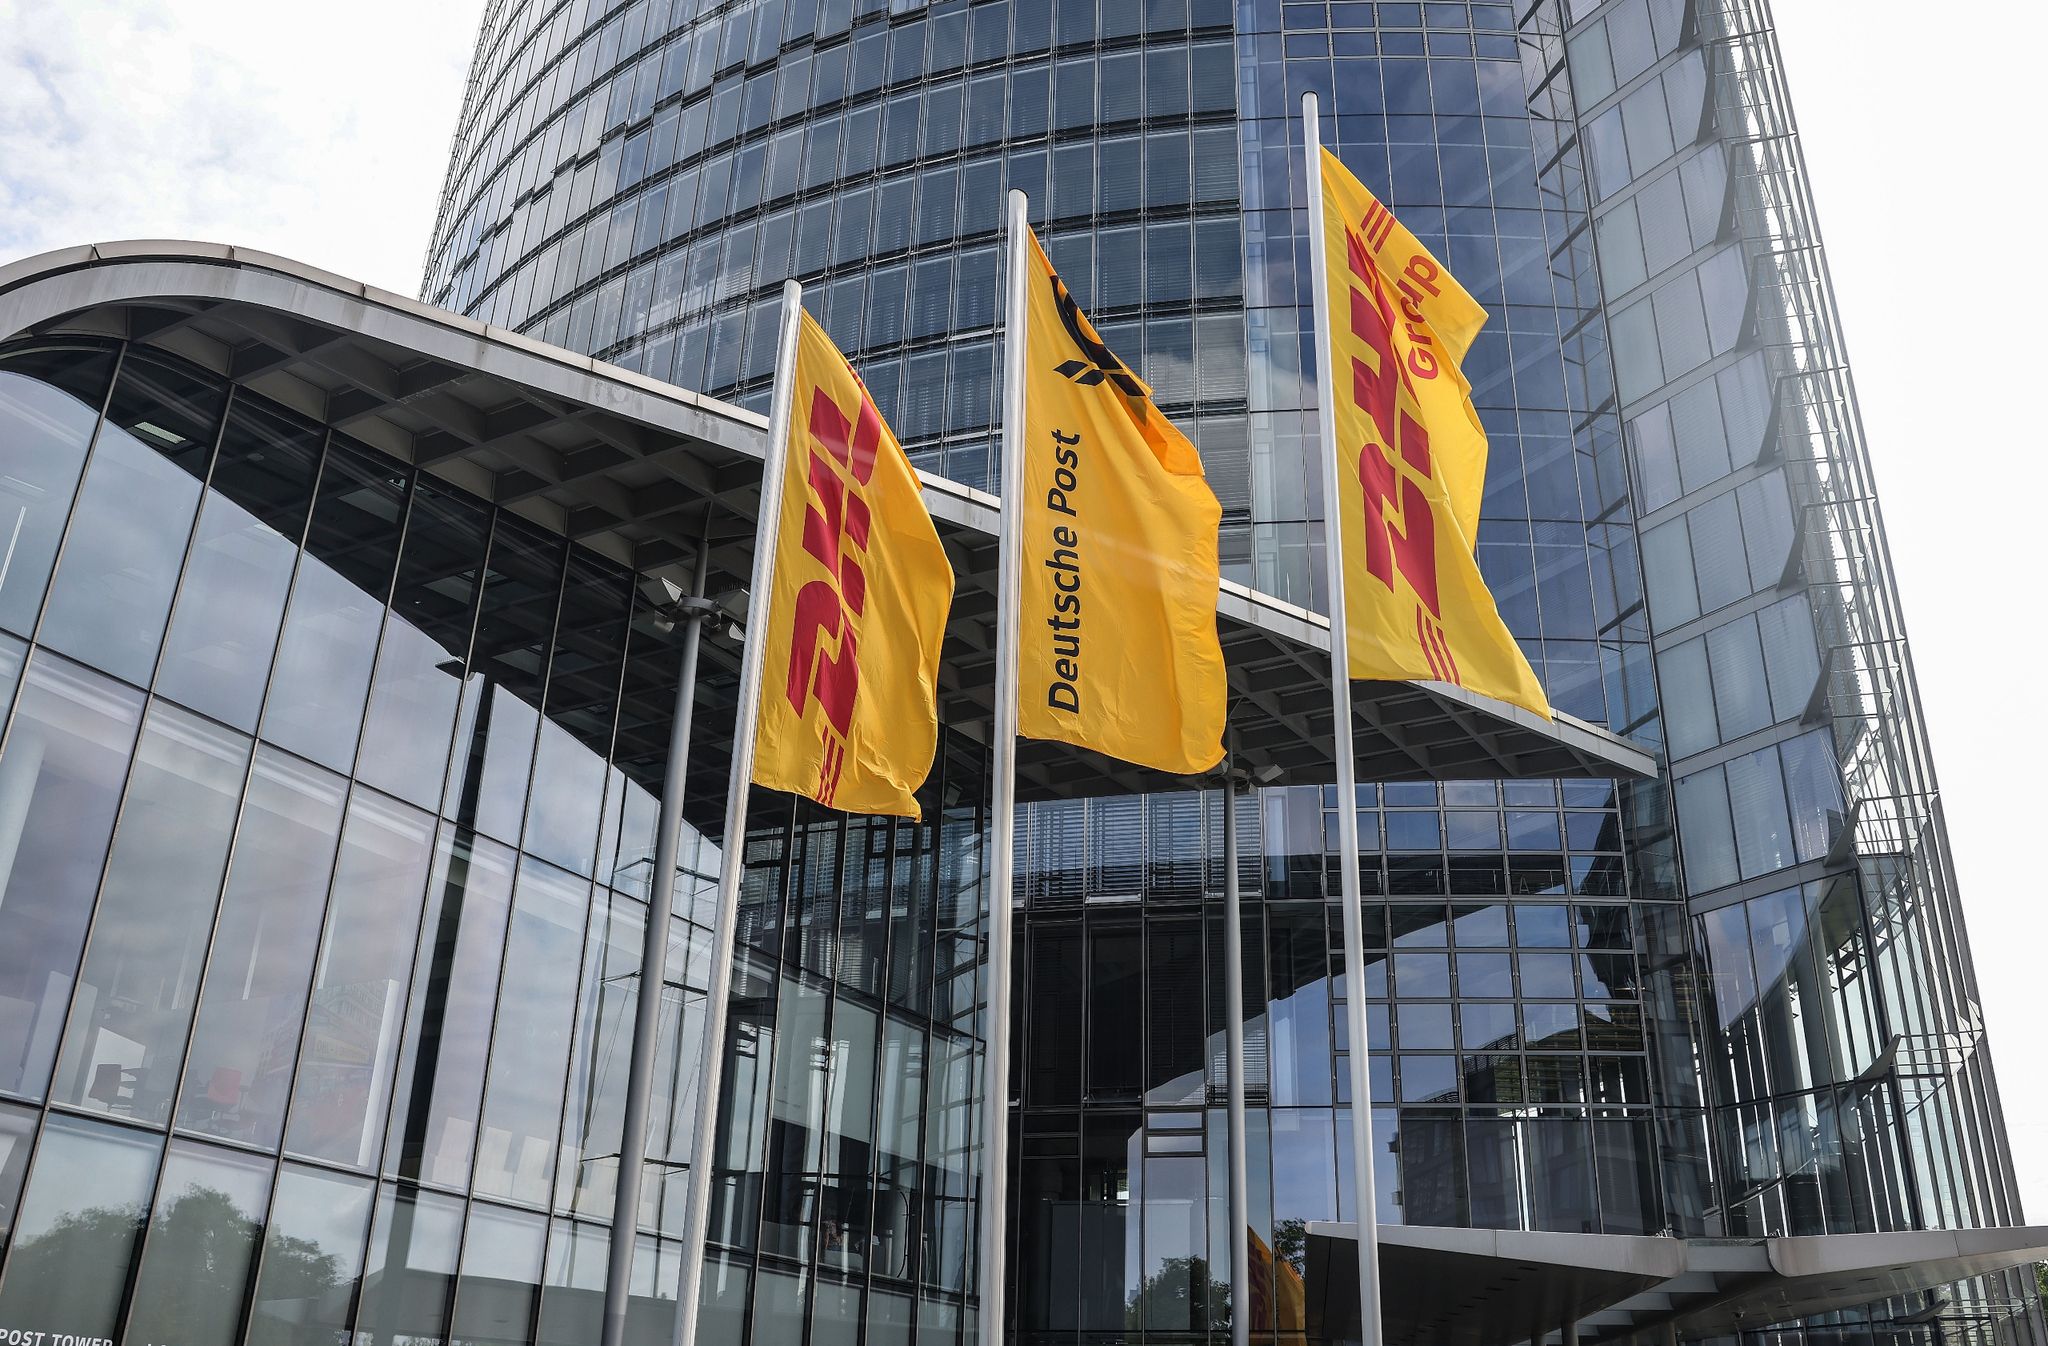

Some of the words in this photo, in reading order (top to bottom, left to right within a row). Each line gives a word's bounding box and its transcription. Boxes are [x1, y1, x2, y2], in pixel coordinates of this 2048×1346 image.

[786, 386, 881, 739] DHL
[1047, 428, 1081, 518] Post
[1048, 525, 1082, 715] Deutsche
